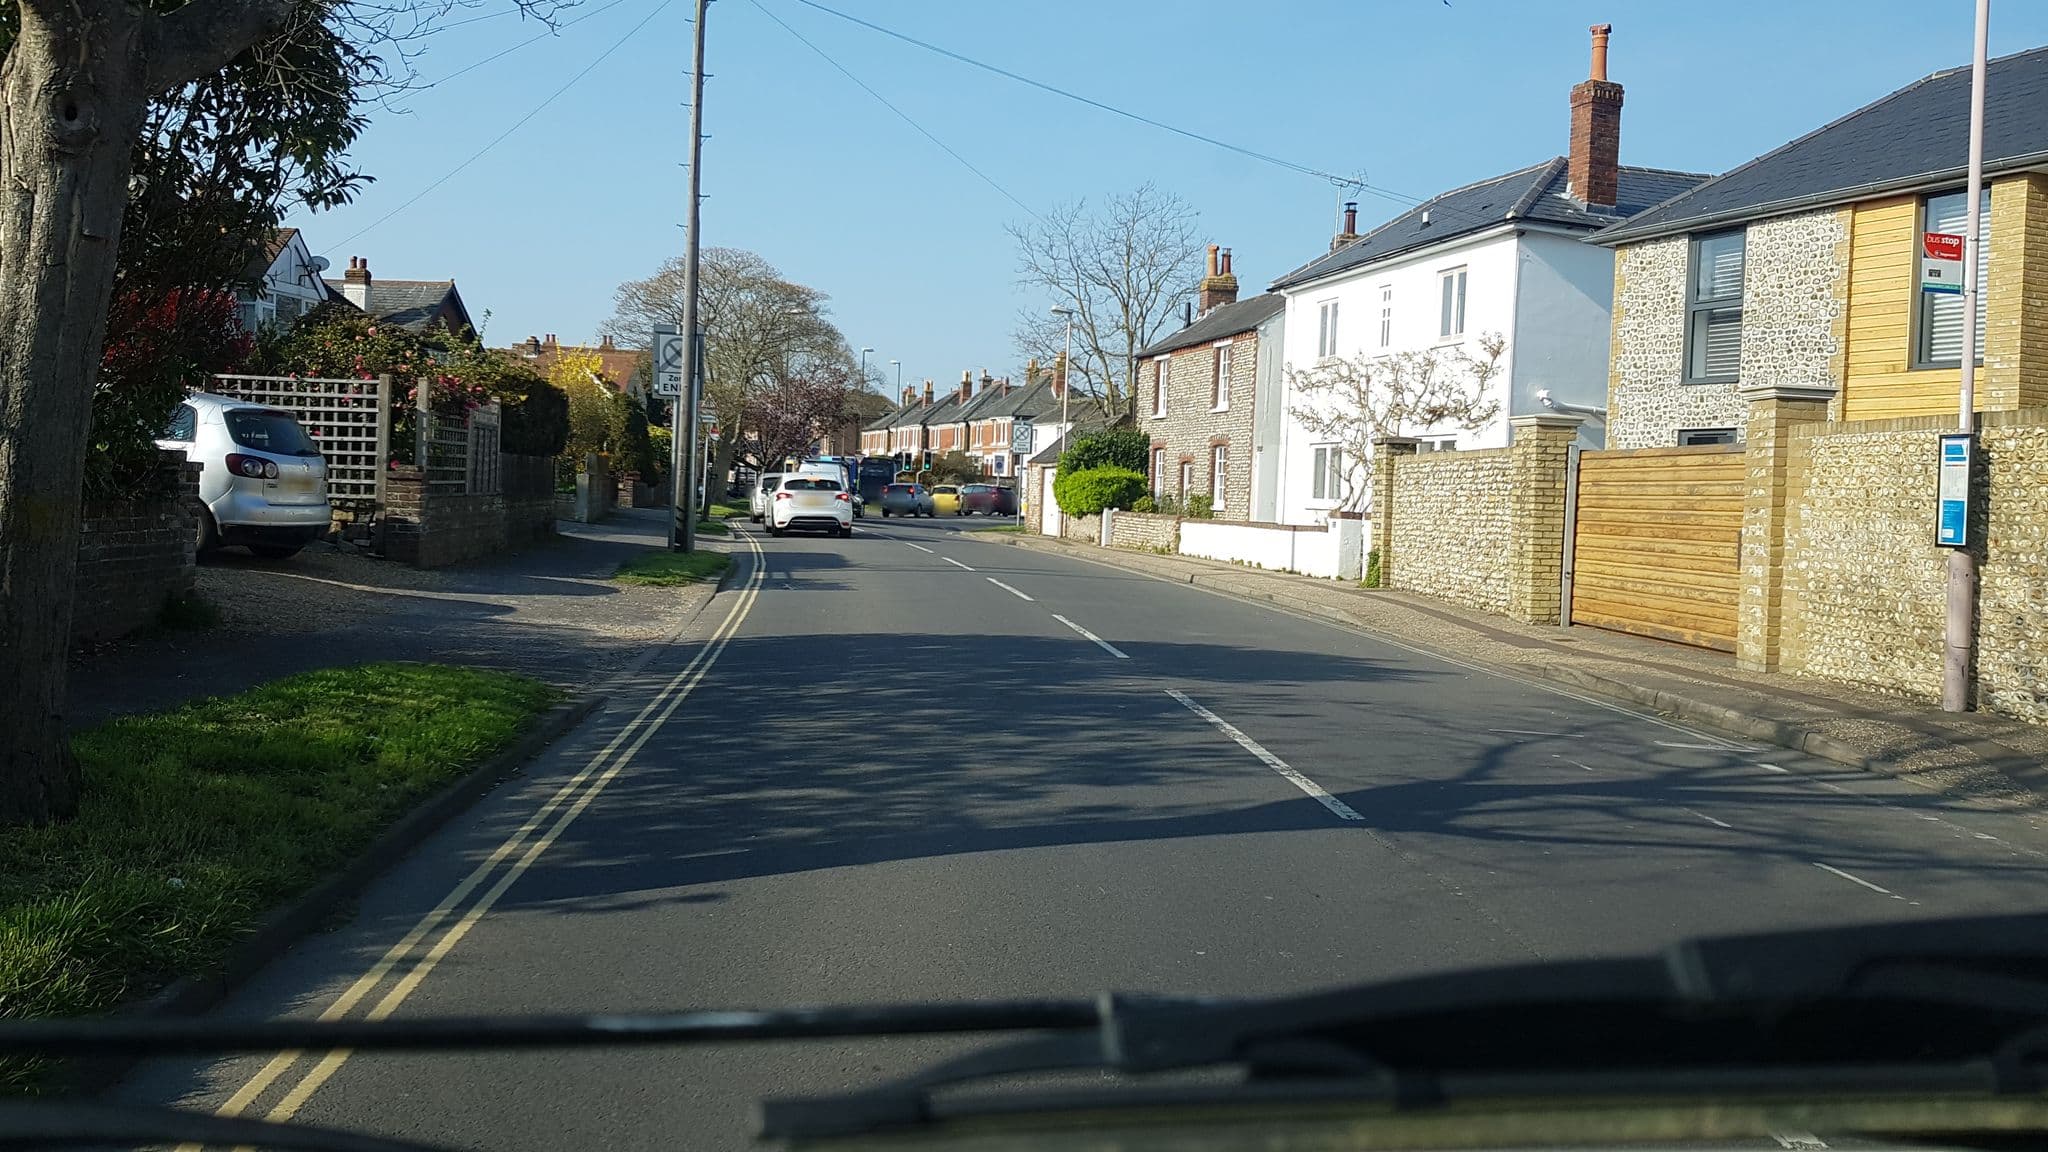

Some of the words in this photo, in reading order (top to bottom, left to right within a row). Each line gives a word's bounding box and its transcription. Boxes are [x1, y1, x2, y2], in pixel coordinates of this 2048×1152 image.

[1927, 234, 1940, 243] bus
[1941, 237, 1959, 247] stop
[668, 374, 681, 382] Zo
[663, 383, 681, 392] EN
